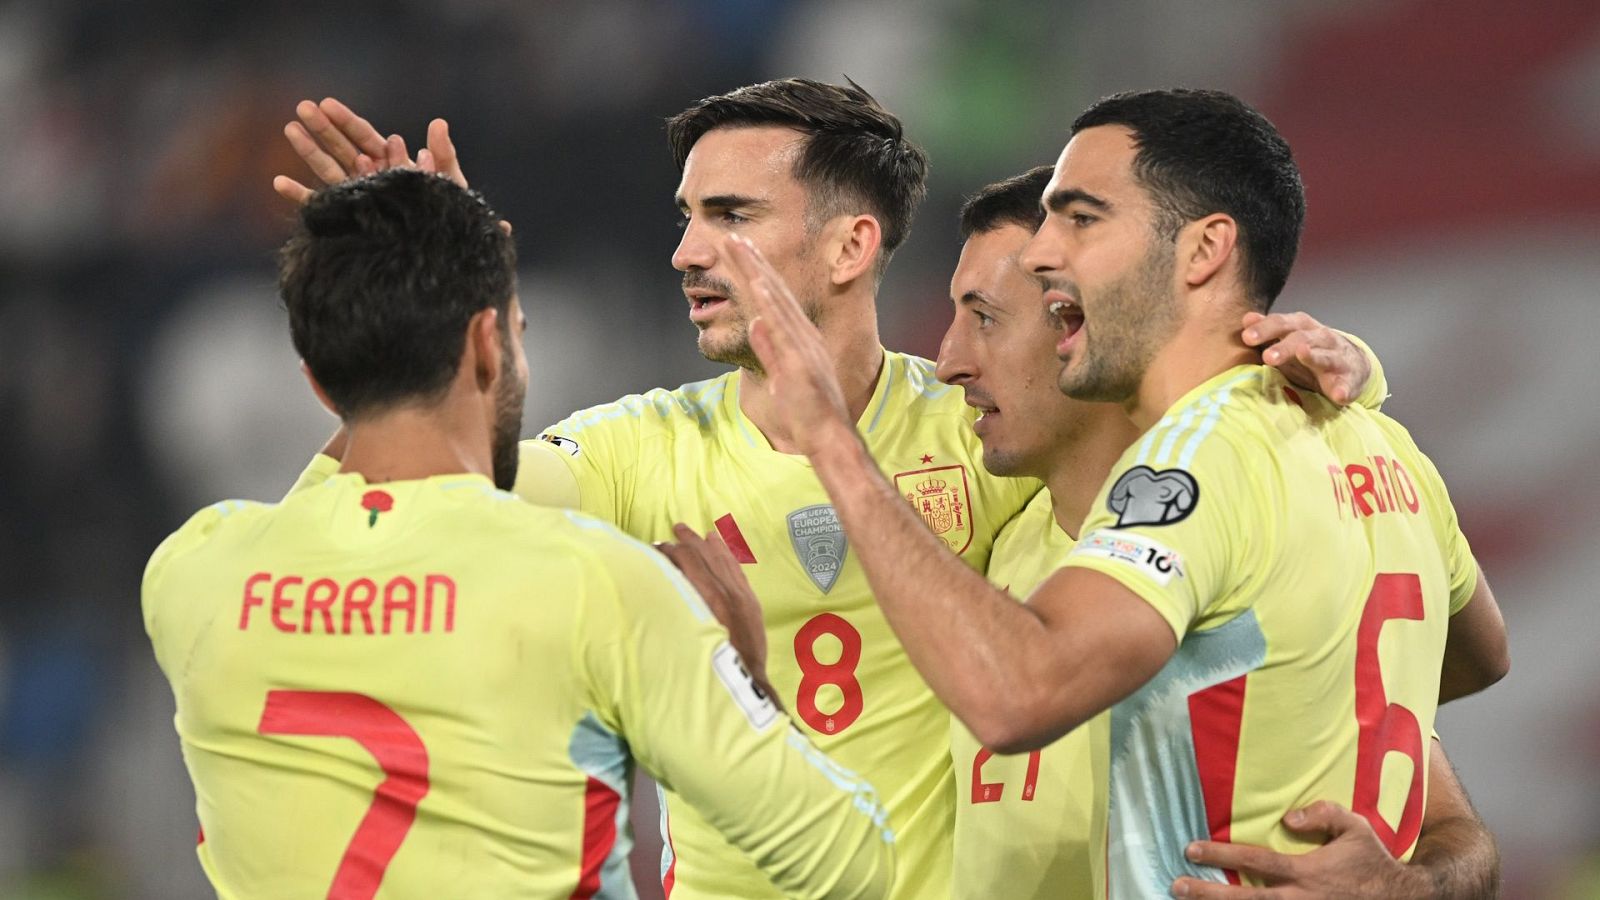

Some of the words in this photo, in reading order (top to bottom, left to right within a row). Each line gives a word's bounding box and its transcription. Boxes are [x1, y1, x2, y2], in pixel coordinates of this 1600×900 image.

[794, 515, 839, 528] EUROPEA
[794, 524, 843, 537] CHAMPION
[808, 508, 829, 517] UEFA
[811, 561, 837, 573] 2024
[239, 572, 457, 635] FERRAN
[794, 612, 864, 736] 8
[1352, 572, 1425, 860] 6
[257, 689, 430, 900] 7
